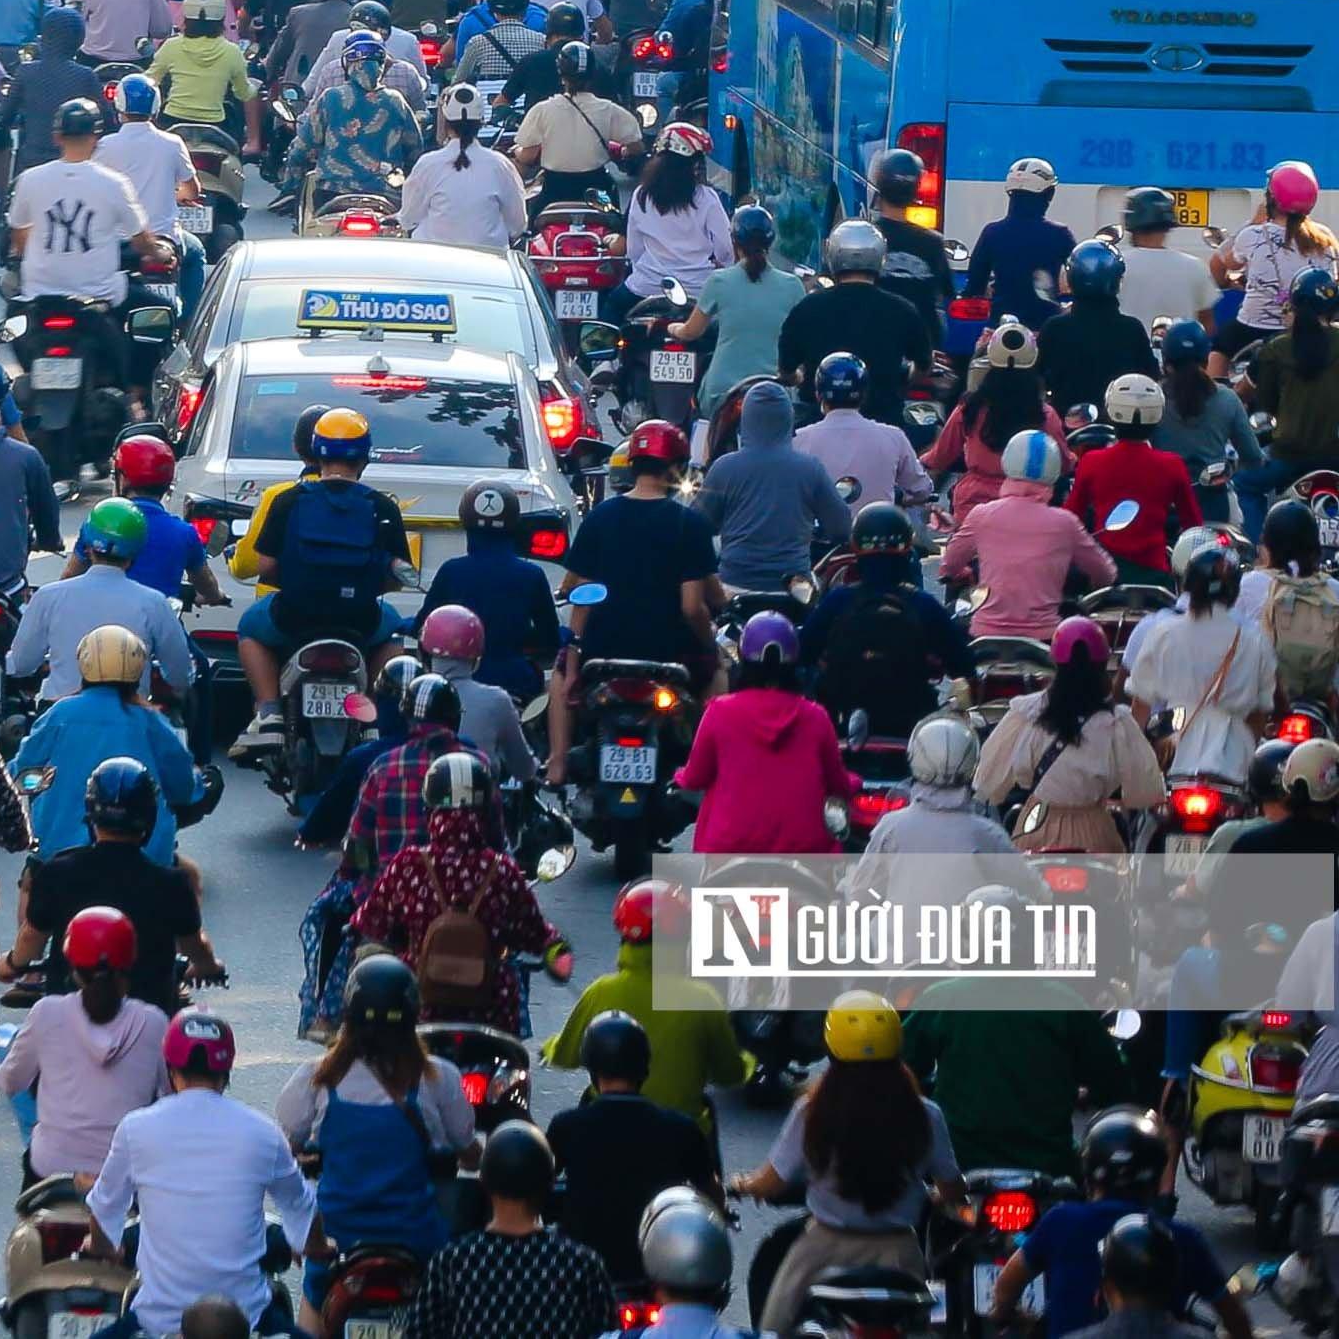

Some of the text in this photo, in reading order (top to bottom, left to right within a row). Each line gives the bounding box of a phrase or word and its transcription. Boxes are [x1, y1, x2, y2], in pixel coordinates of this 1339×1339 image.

[44, 197, 96, 254] NY
[1179, 209, 1200, 224] 83
[340, 297, 450, 321] THỦ ĐÔ SAO
[306, 701, 345, 715] 288.2
[1255, 1118, 1272, 1137] 30
